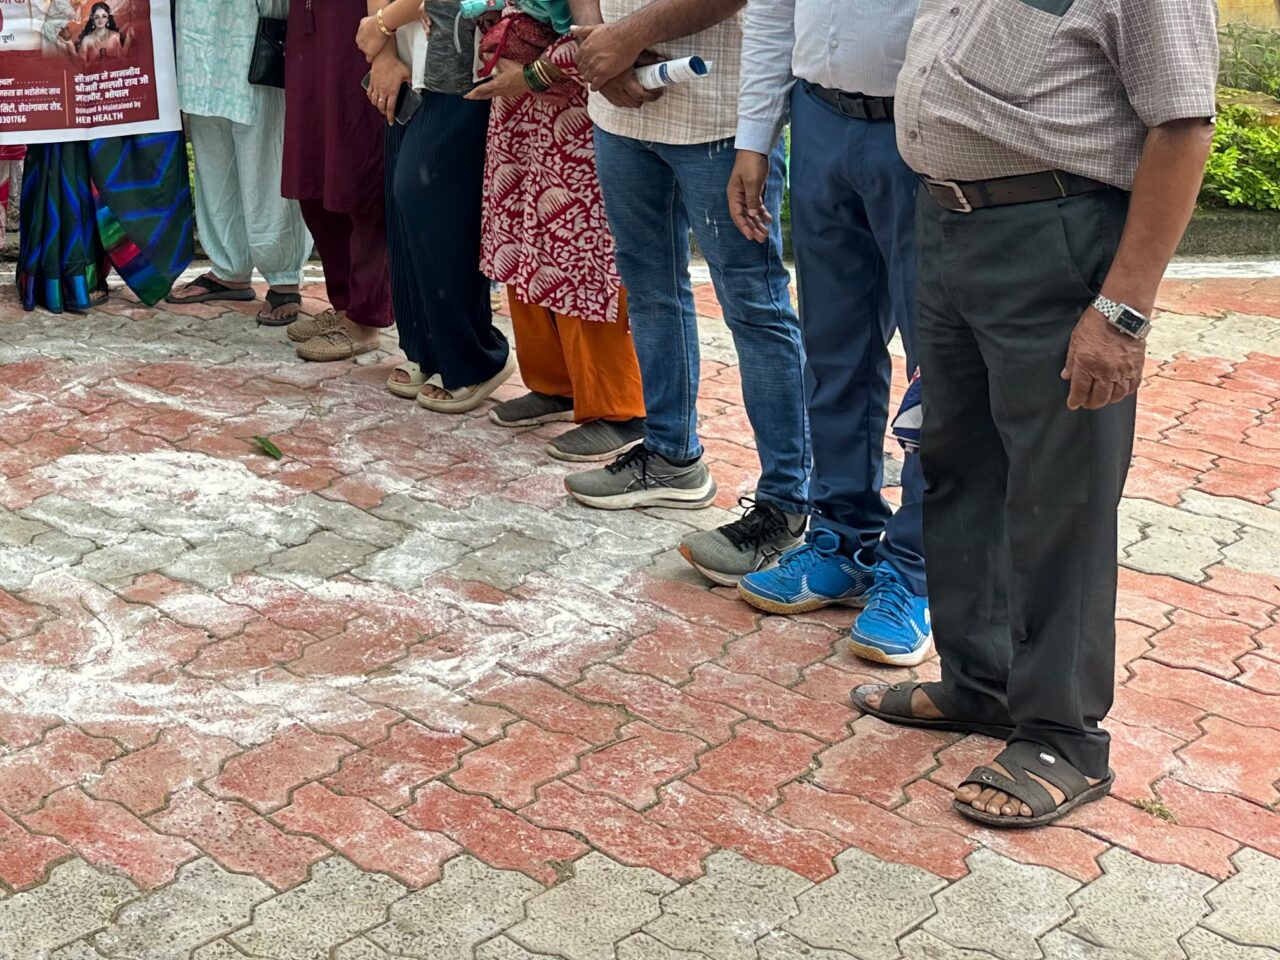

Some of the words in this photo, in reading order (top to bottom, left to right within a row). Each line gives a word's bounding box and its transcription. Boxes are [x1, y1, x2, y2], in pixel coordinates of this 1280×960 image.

[100, 70, 108, 79] से
[110, 66, 141, 78] माननीय
[104, 89, 129, 99] भोपाल
[75, 116, 91, 124] HER
[92, 111, 123, 123] HEALTH
